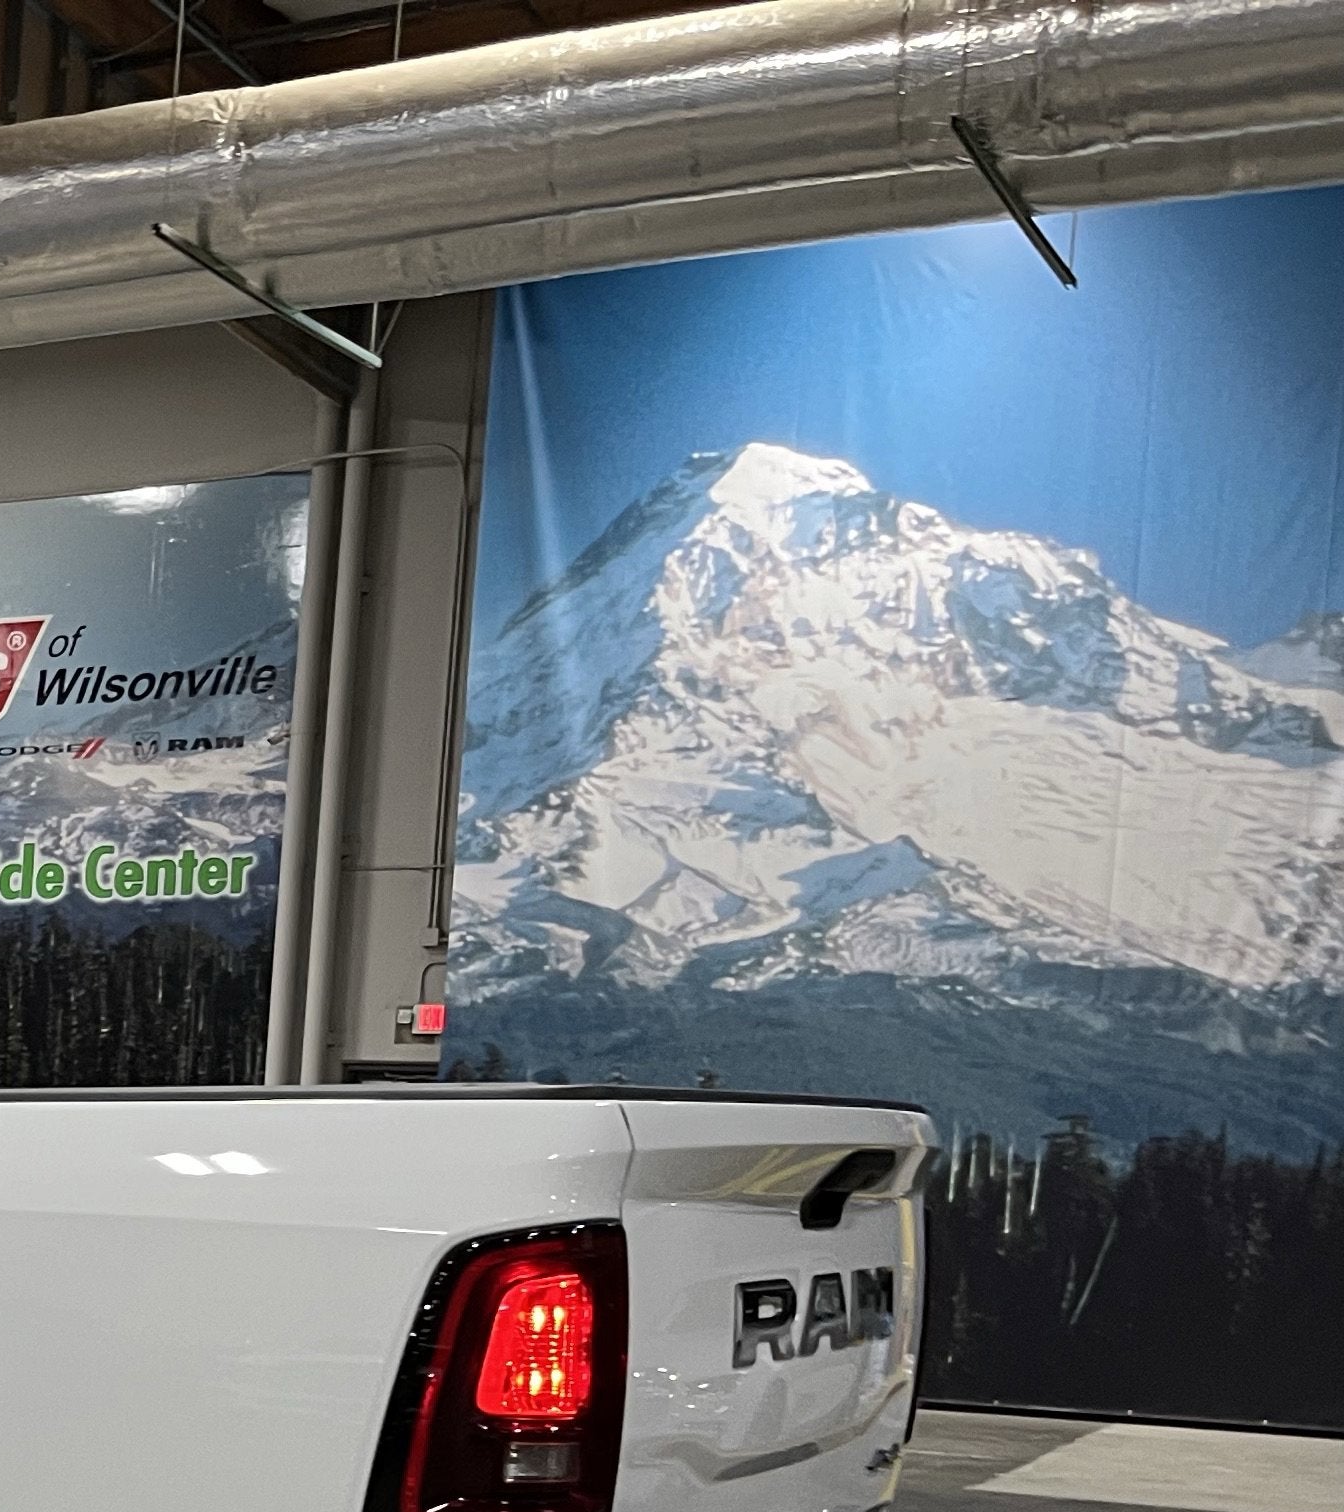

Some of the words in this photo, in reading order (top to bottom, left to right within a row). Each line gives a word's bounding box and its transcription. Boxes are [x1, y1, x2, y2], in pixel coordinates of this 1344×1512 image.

[48, 625, 87, 657] of
[35, 655, 278, 706] Wilsonville
[167, 736, 245, 752] RAM
[85, 845, 254, 899] Center
[732, 1266, 894, 1369] RAM
